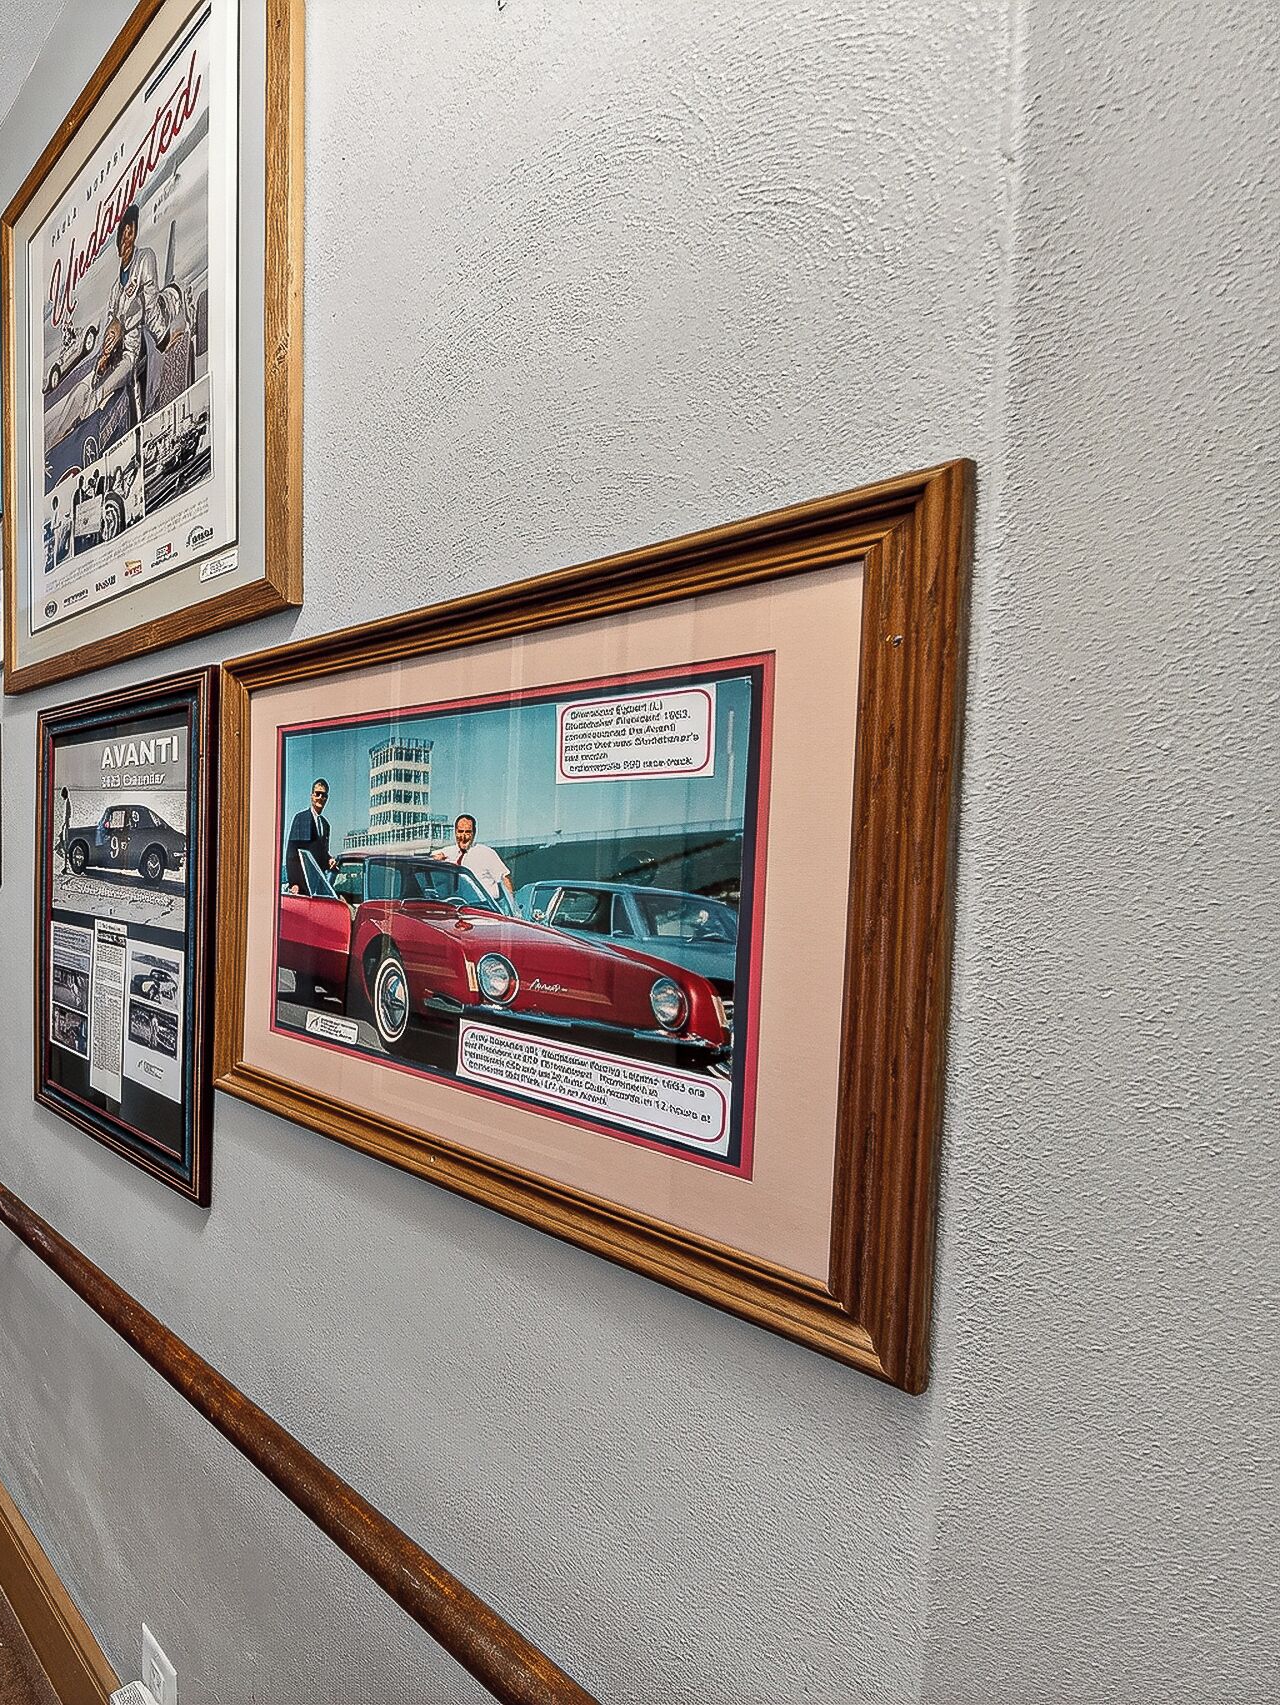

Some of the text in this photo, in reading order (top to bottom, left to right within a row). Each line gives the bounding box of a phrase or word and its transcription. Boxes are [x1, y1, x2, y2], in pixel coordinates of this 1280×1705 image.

[50, 50, 201, 326] Undaunted
[101, 735, 179, 770] AVANTI
[110, 836, 120, 859] 9
